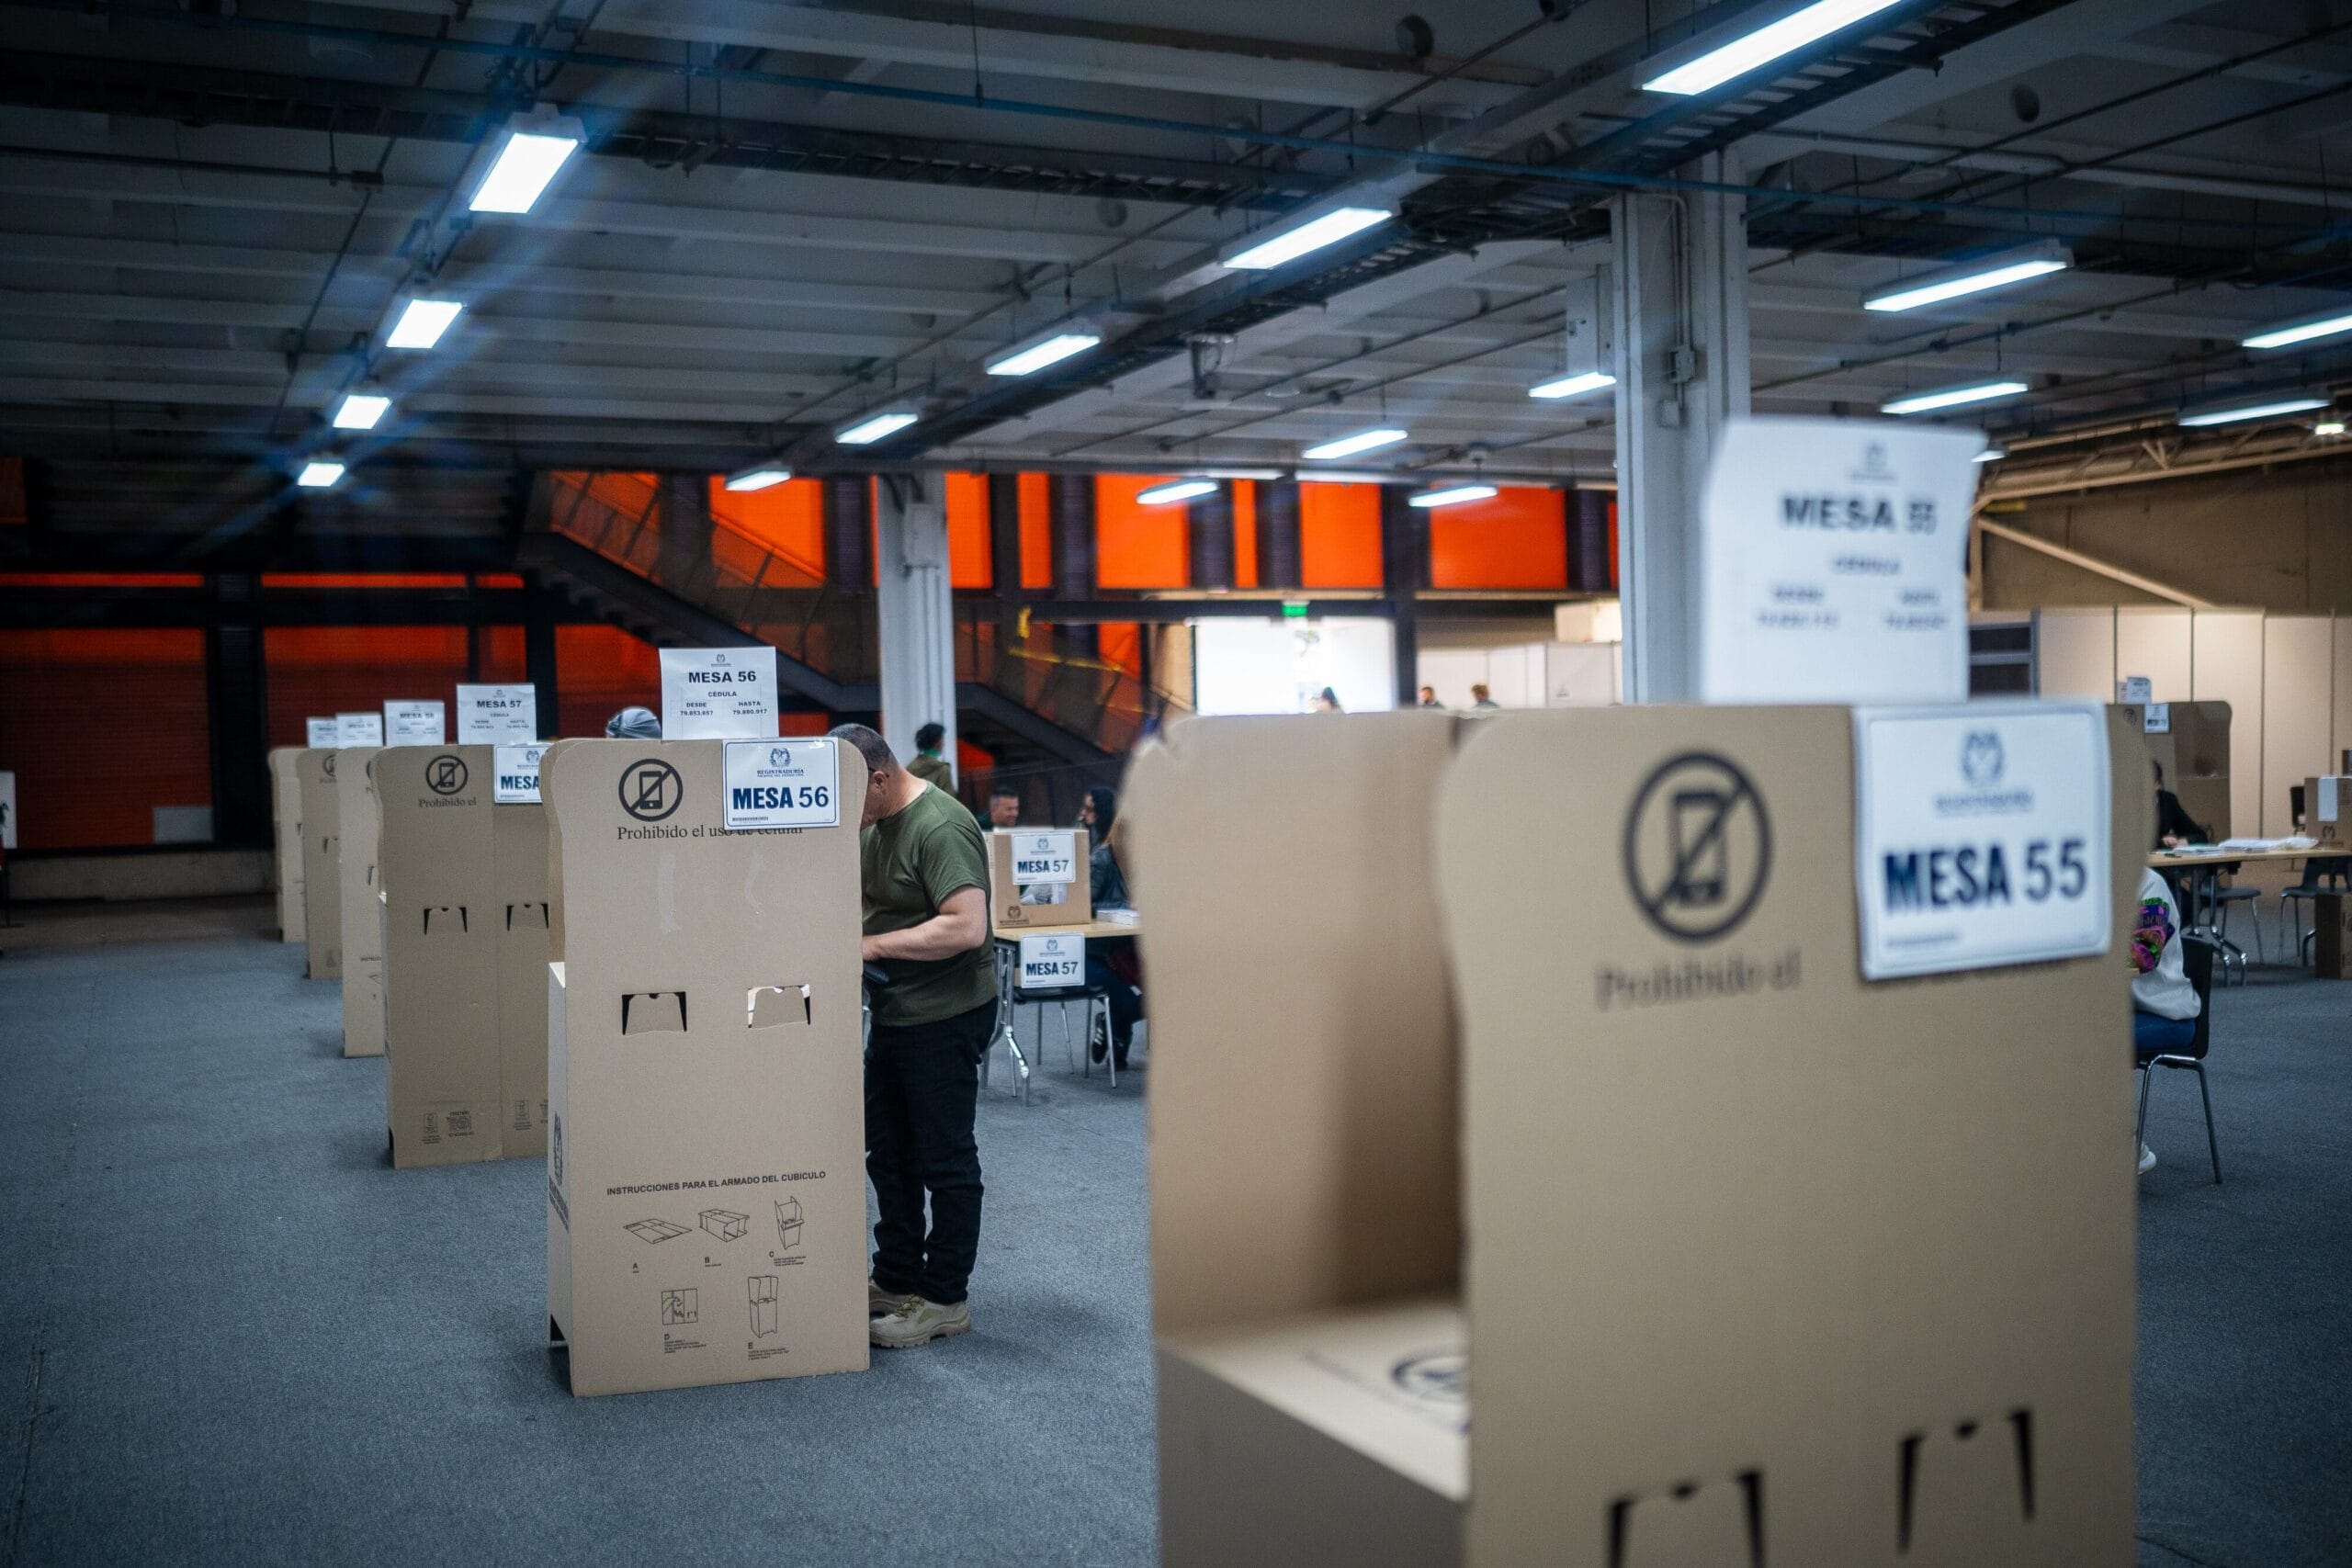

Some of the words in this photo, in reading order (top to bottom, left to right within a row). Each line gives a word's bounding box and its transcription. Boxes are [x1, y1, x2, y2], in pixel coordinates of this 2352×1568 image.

[1781, 493, 1895, 531] MESA
[688, 671, 732, 683] MESA
[738, 671, 757, 682] 56
[707, 690, 738, 698] CÉDULA
[477, 700, 507, 708] MESA
[510, 700, 523, 708] 57
[500, 775, 540, 790] MESA
[418, 797, 466, 808] Prohibido
[469, 796, 477, 806] el
[732, 787, 794, 810] MESA
[798, 786, 829, 808] 56
[616, 826, 688, 840] Prohibido
[692, 825, 704, 838] el
[1017, 860, 1050, 874] MESA
[1053, 860, 1069, 873] 57
[1883, 845, 2011, 917] MESA
[2025, 839, 2087, 904] 55
[1025, 963, 1059, 976] MESA
[1061, 962, 1079, 975] 57
[606, 1182, 680, 1195] INSTRUCCIONES
[683, 1180, 707, 1190] PARA
[708, 1179, 719, 1188] EL
[721, 1176, 760, 1187] ARMADO
[762, 1174, 779, 1183] DEL
[781, 1171, 826, 1182] CUBICULO
